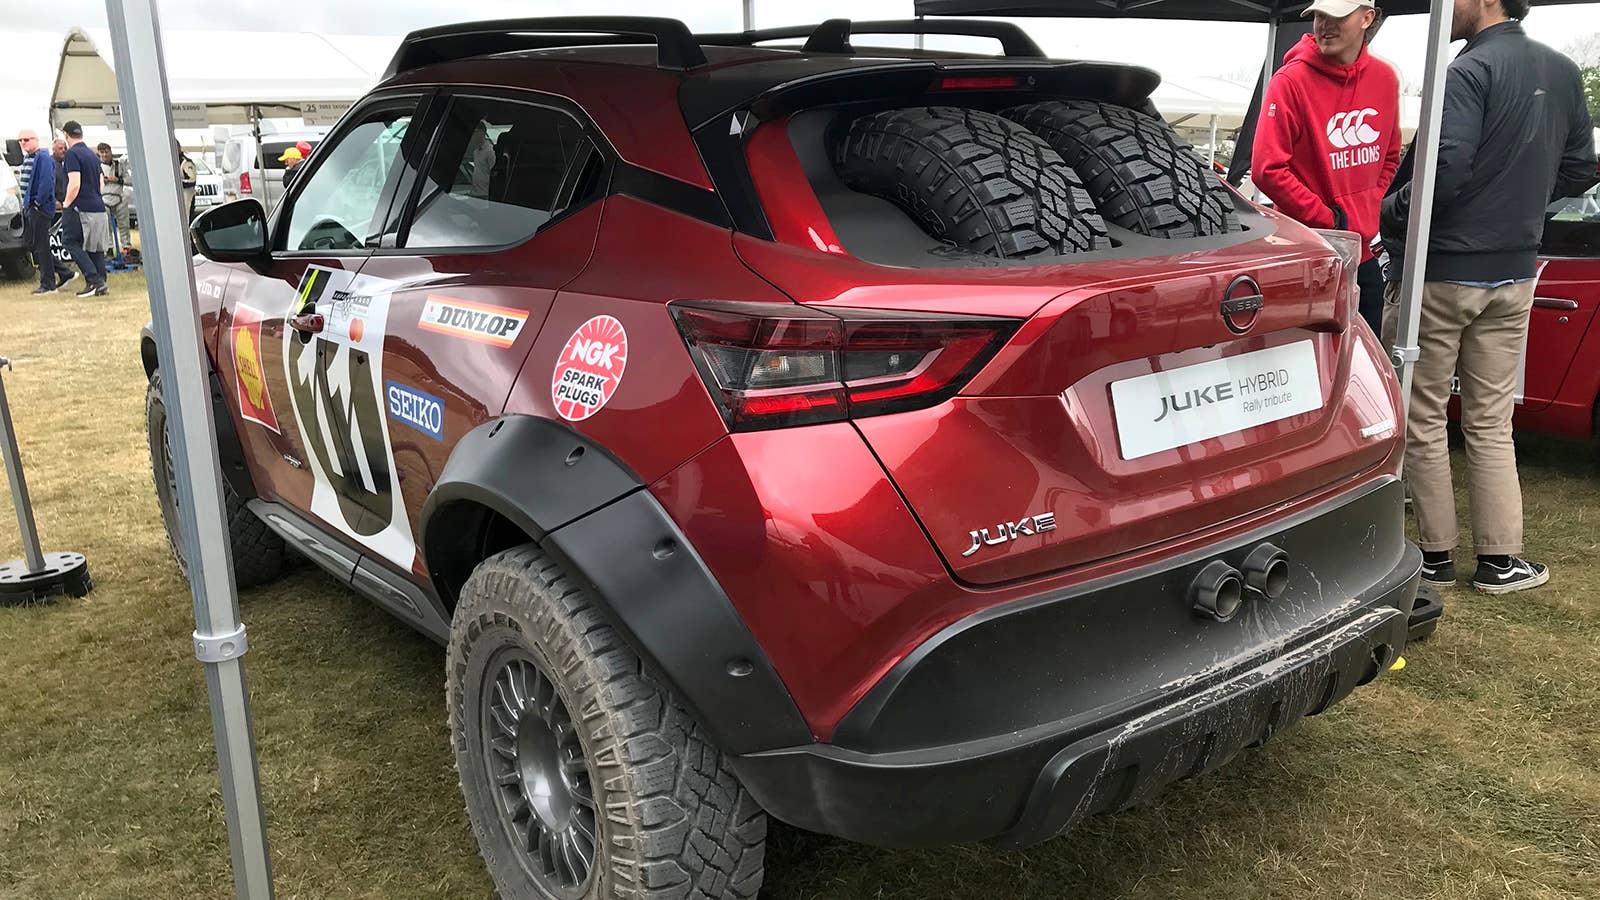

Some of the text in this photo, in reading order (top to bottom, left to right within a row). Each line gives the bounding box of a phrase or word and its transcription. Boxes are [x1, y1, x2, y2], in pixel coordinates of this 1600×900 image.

[306, 103, 317, 111] 25
[1329, 144, 1380, 170] THE LIONS
[437, 306, 520, 337] DUNLOP
[569, 337, 620, 370] NGK
[563, 369, 605, 391] SPARK
[557, 384, 599, 406] PLUGS
[1153, 368, 1290, 423] JUKE HYBRID
[1243, 391, 1293, 415] Rally tribute
[389, 386, 442, 434] SEIKO
[961, 512, 1058, 557] JUKE
